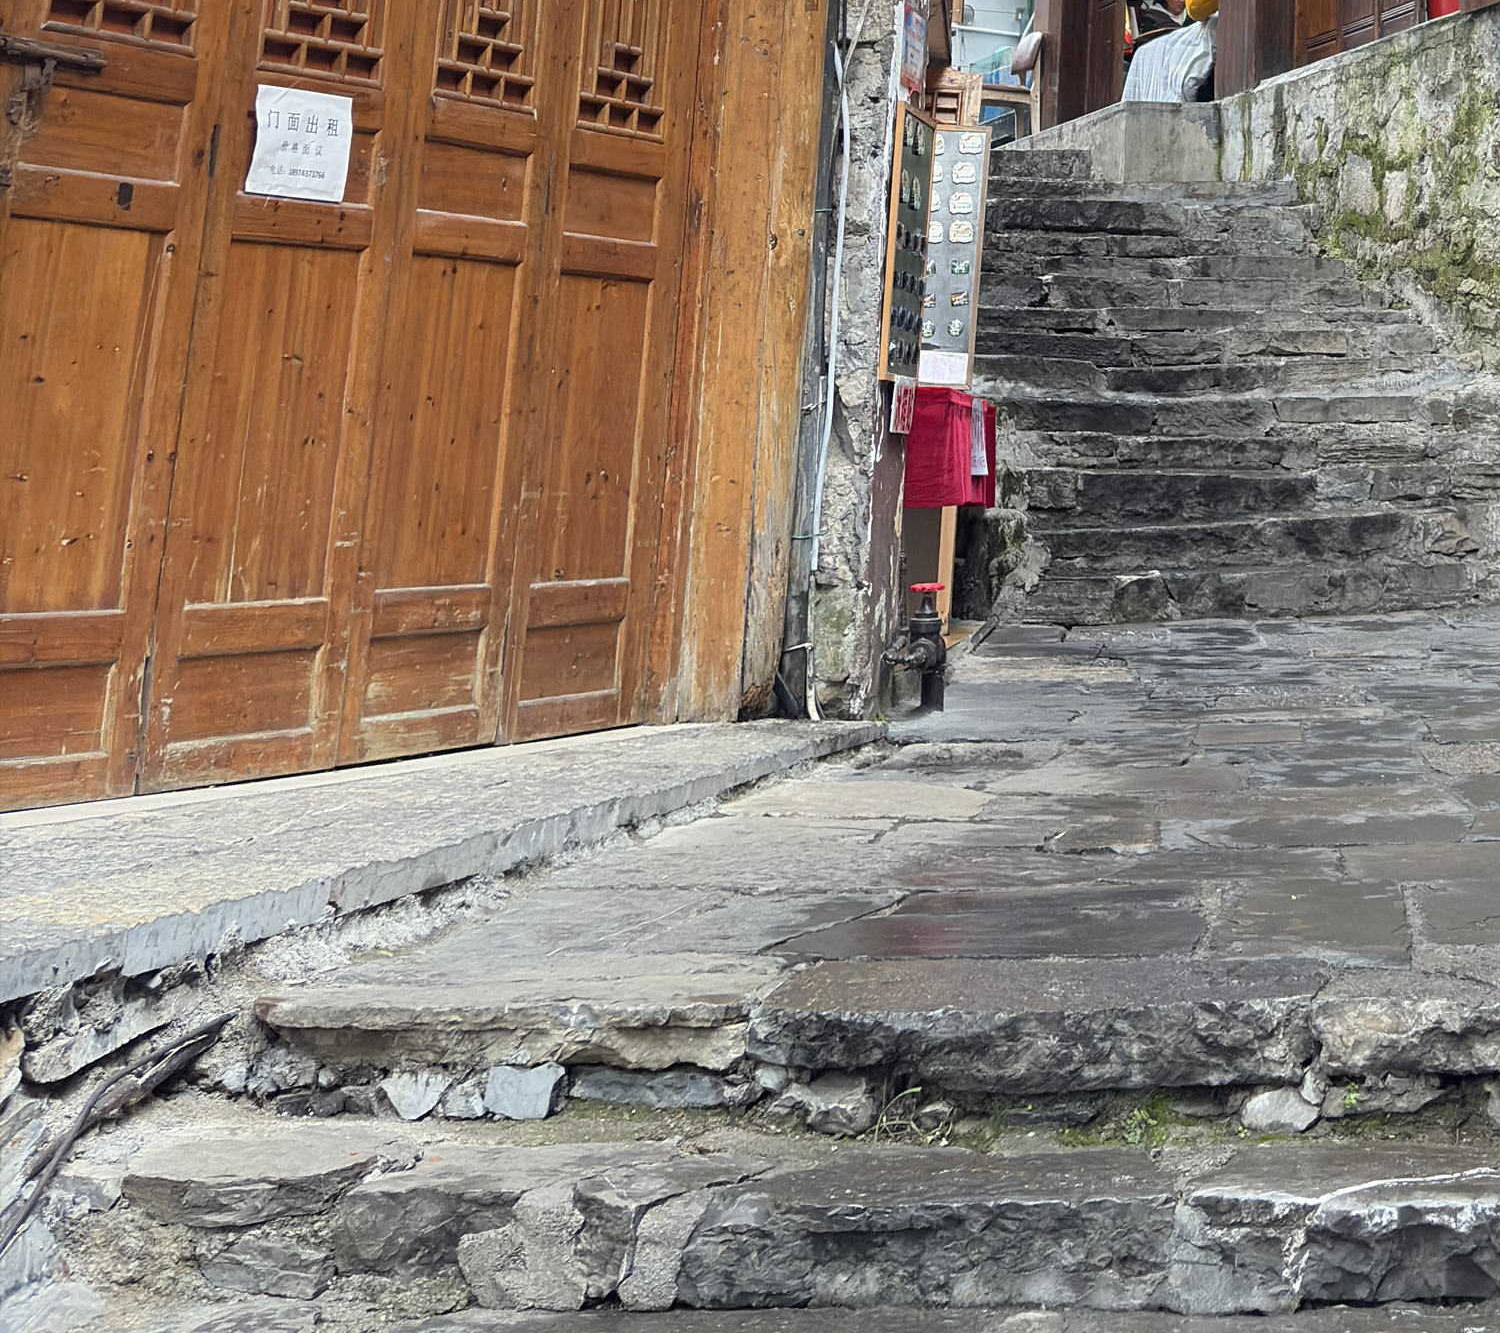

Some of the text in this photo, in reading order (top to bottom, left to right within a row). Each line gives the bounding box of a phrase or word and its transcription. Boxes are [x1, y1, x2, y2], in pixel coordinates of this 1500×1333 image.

[267, 109, 339, 137] 门面出租
[280, 140, 323, 157] 价格面议
